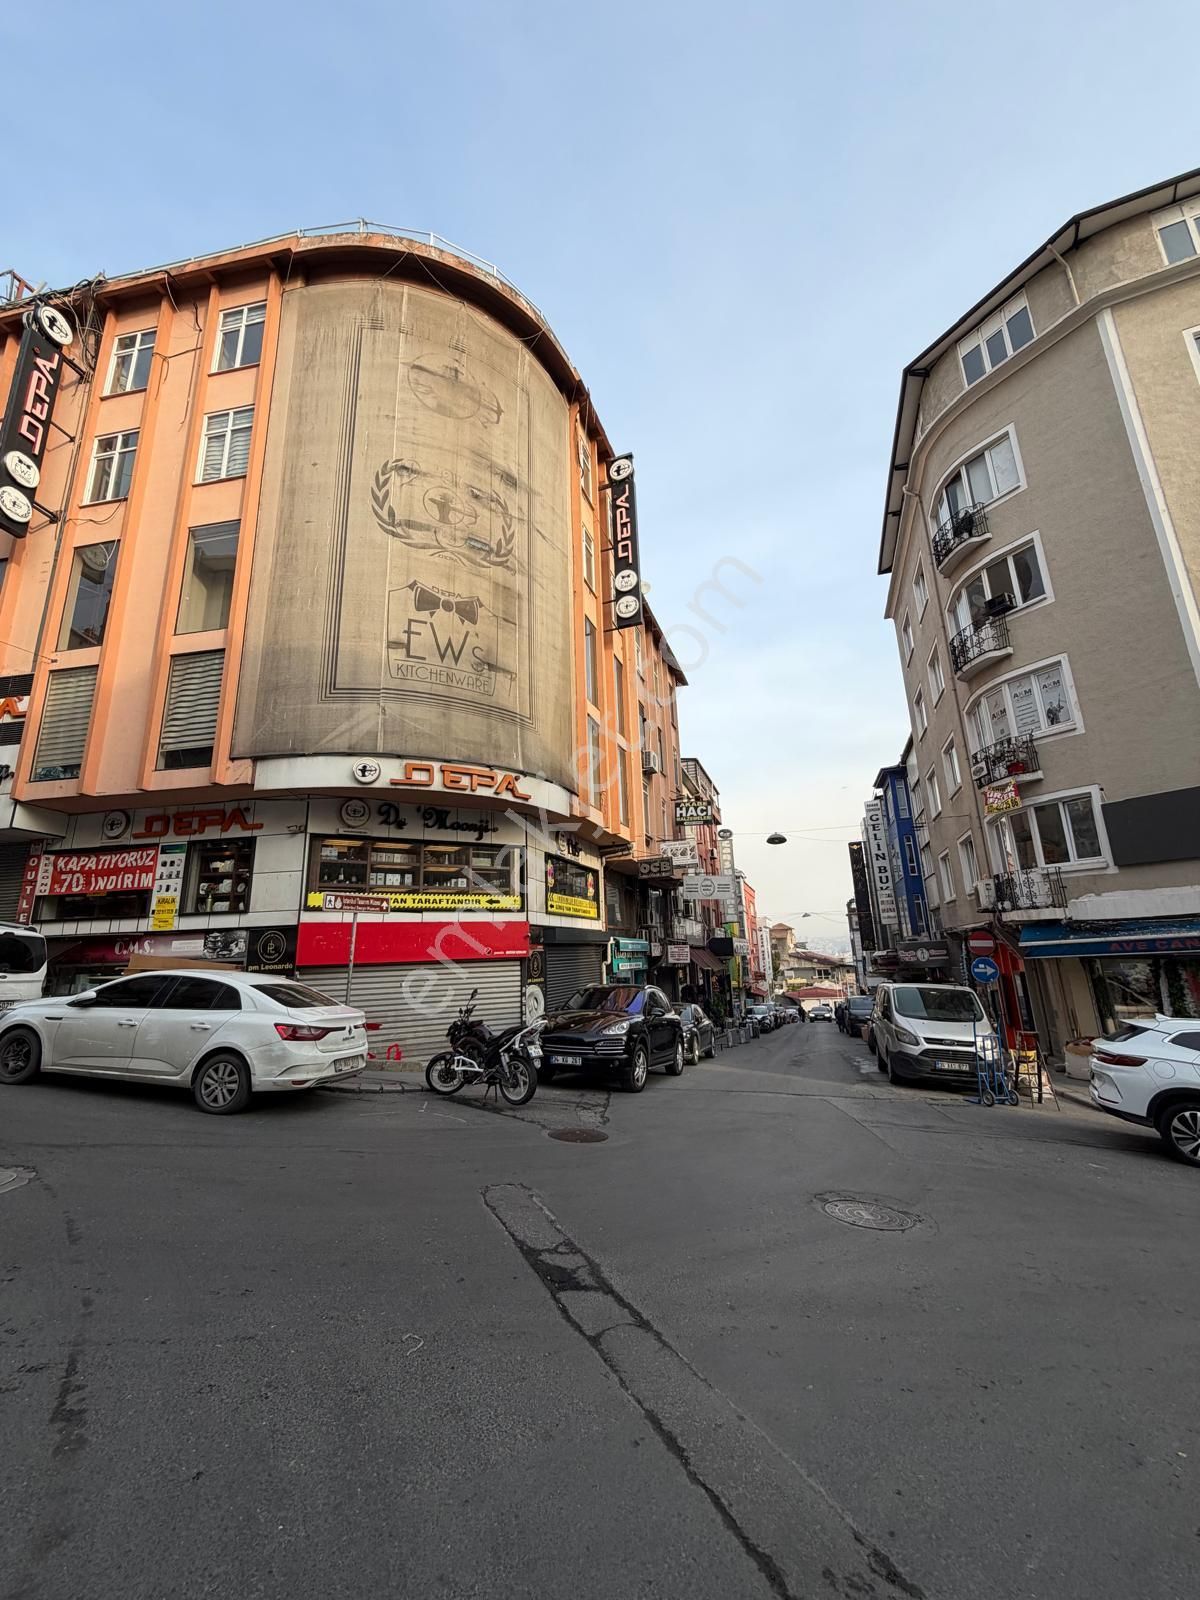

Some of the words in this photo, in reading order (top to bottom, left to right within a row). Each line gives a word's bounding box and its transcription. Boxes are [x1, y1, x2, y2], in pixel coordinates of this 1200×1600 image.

[18, 352, 59, 455] DEPA
[616, 484, 632, 564] DEPA
[396, 663, 489, 692] KITCHENWARE
[390, 762, 531, 801] DEPA
[132, 808, 264, 839] DEPA
[676, 806, 711, 817] HACI
[57, 850, 155, 871] KAPATIYORUZ
[640, 862, 670, 873] OCB
[90, 869, 153, 891] İNDİRİM
[411, 897, 481, 905] TARAFTANDIR
